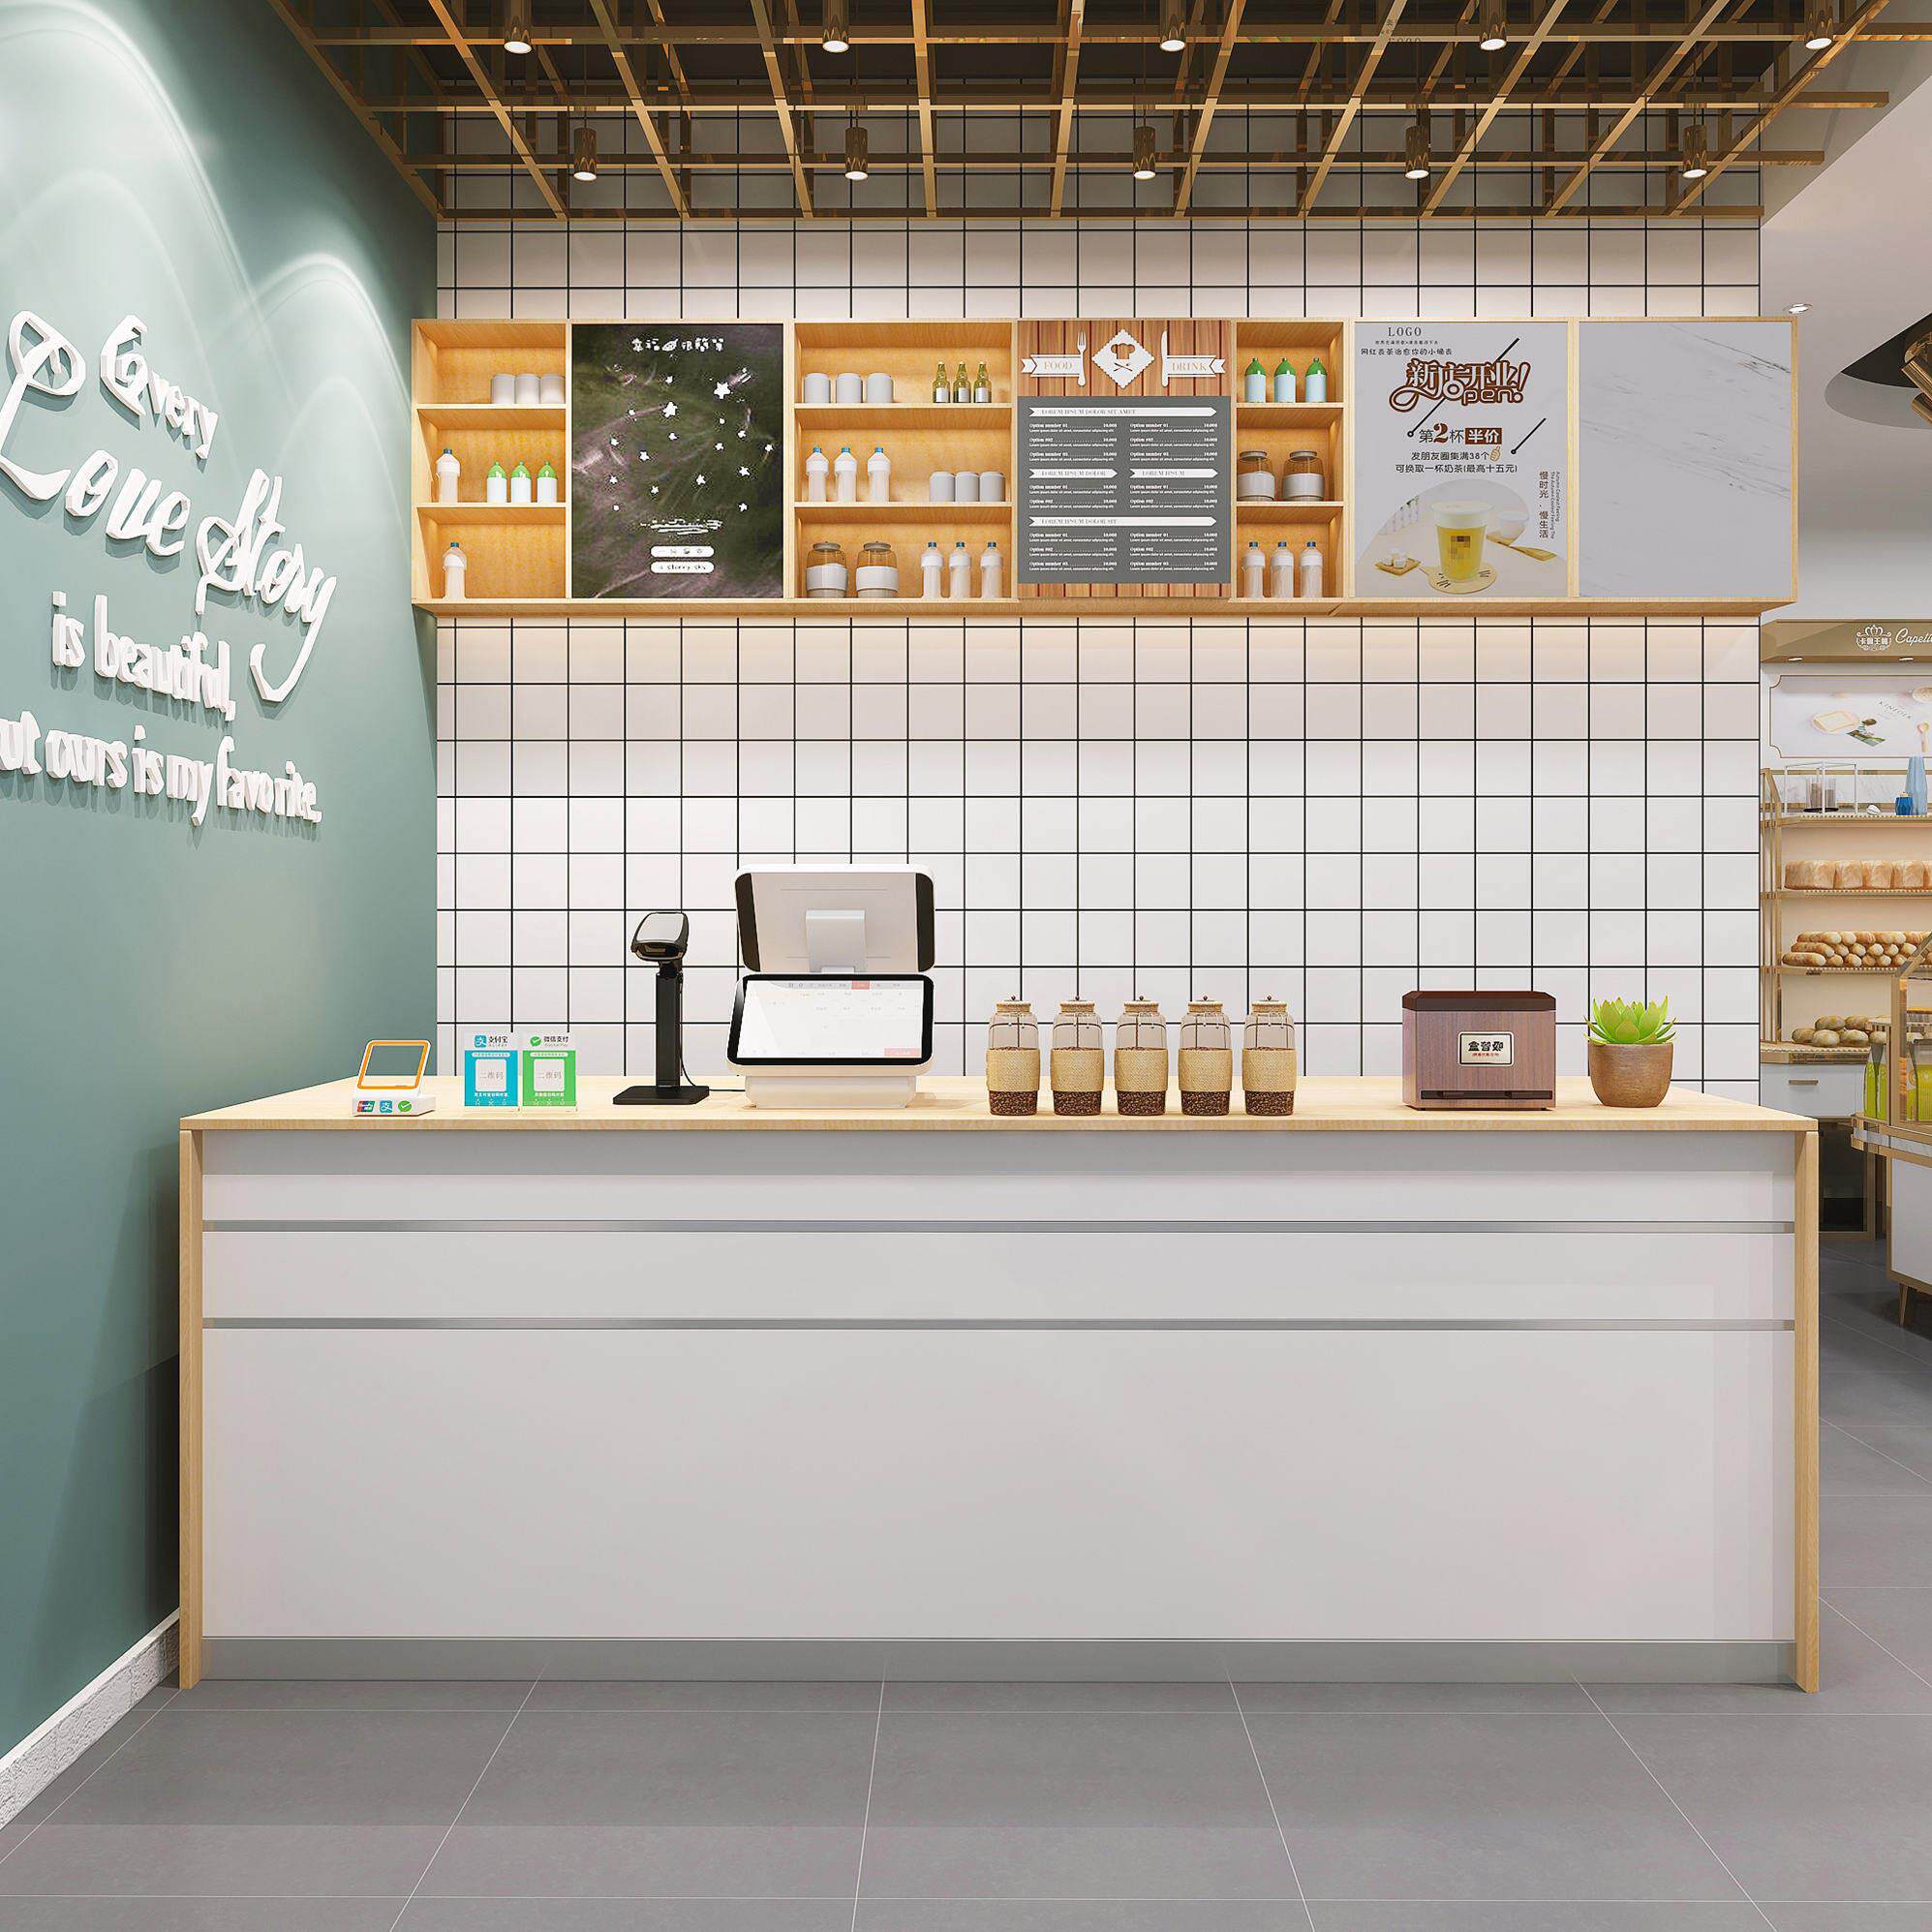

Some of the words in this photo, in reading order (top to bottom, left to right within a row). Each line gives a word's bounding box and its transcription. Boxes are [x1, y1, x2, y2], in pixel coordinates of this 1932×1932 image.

[1388, 326, 1422, 337] LOGO
[1044, 361, 1072, 370] FOOD
[1171, 361, 1207, 371] DRINK
[0, 310, 191, 556] Love
[197, 468, 337, 702] Story
[52, 591, 85, 667] is
[46, 729, 128, 788] ours
[132, 724, 165, 795] is
[167, 753, 213, 826] my
[489, 1035, 508, 1044] 支付宝
